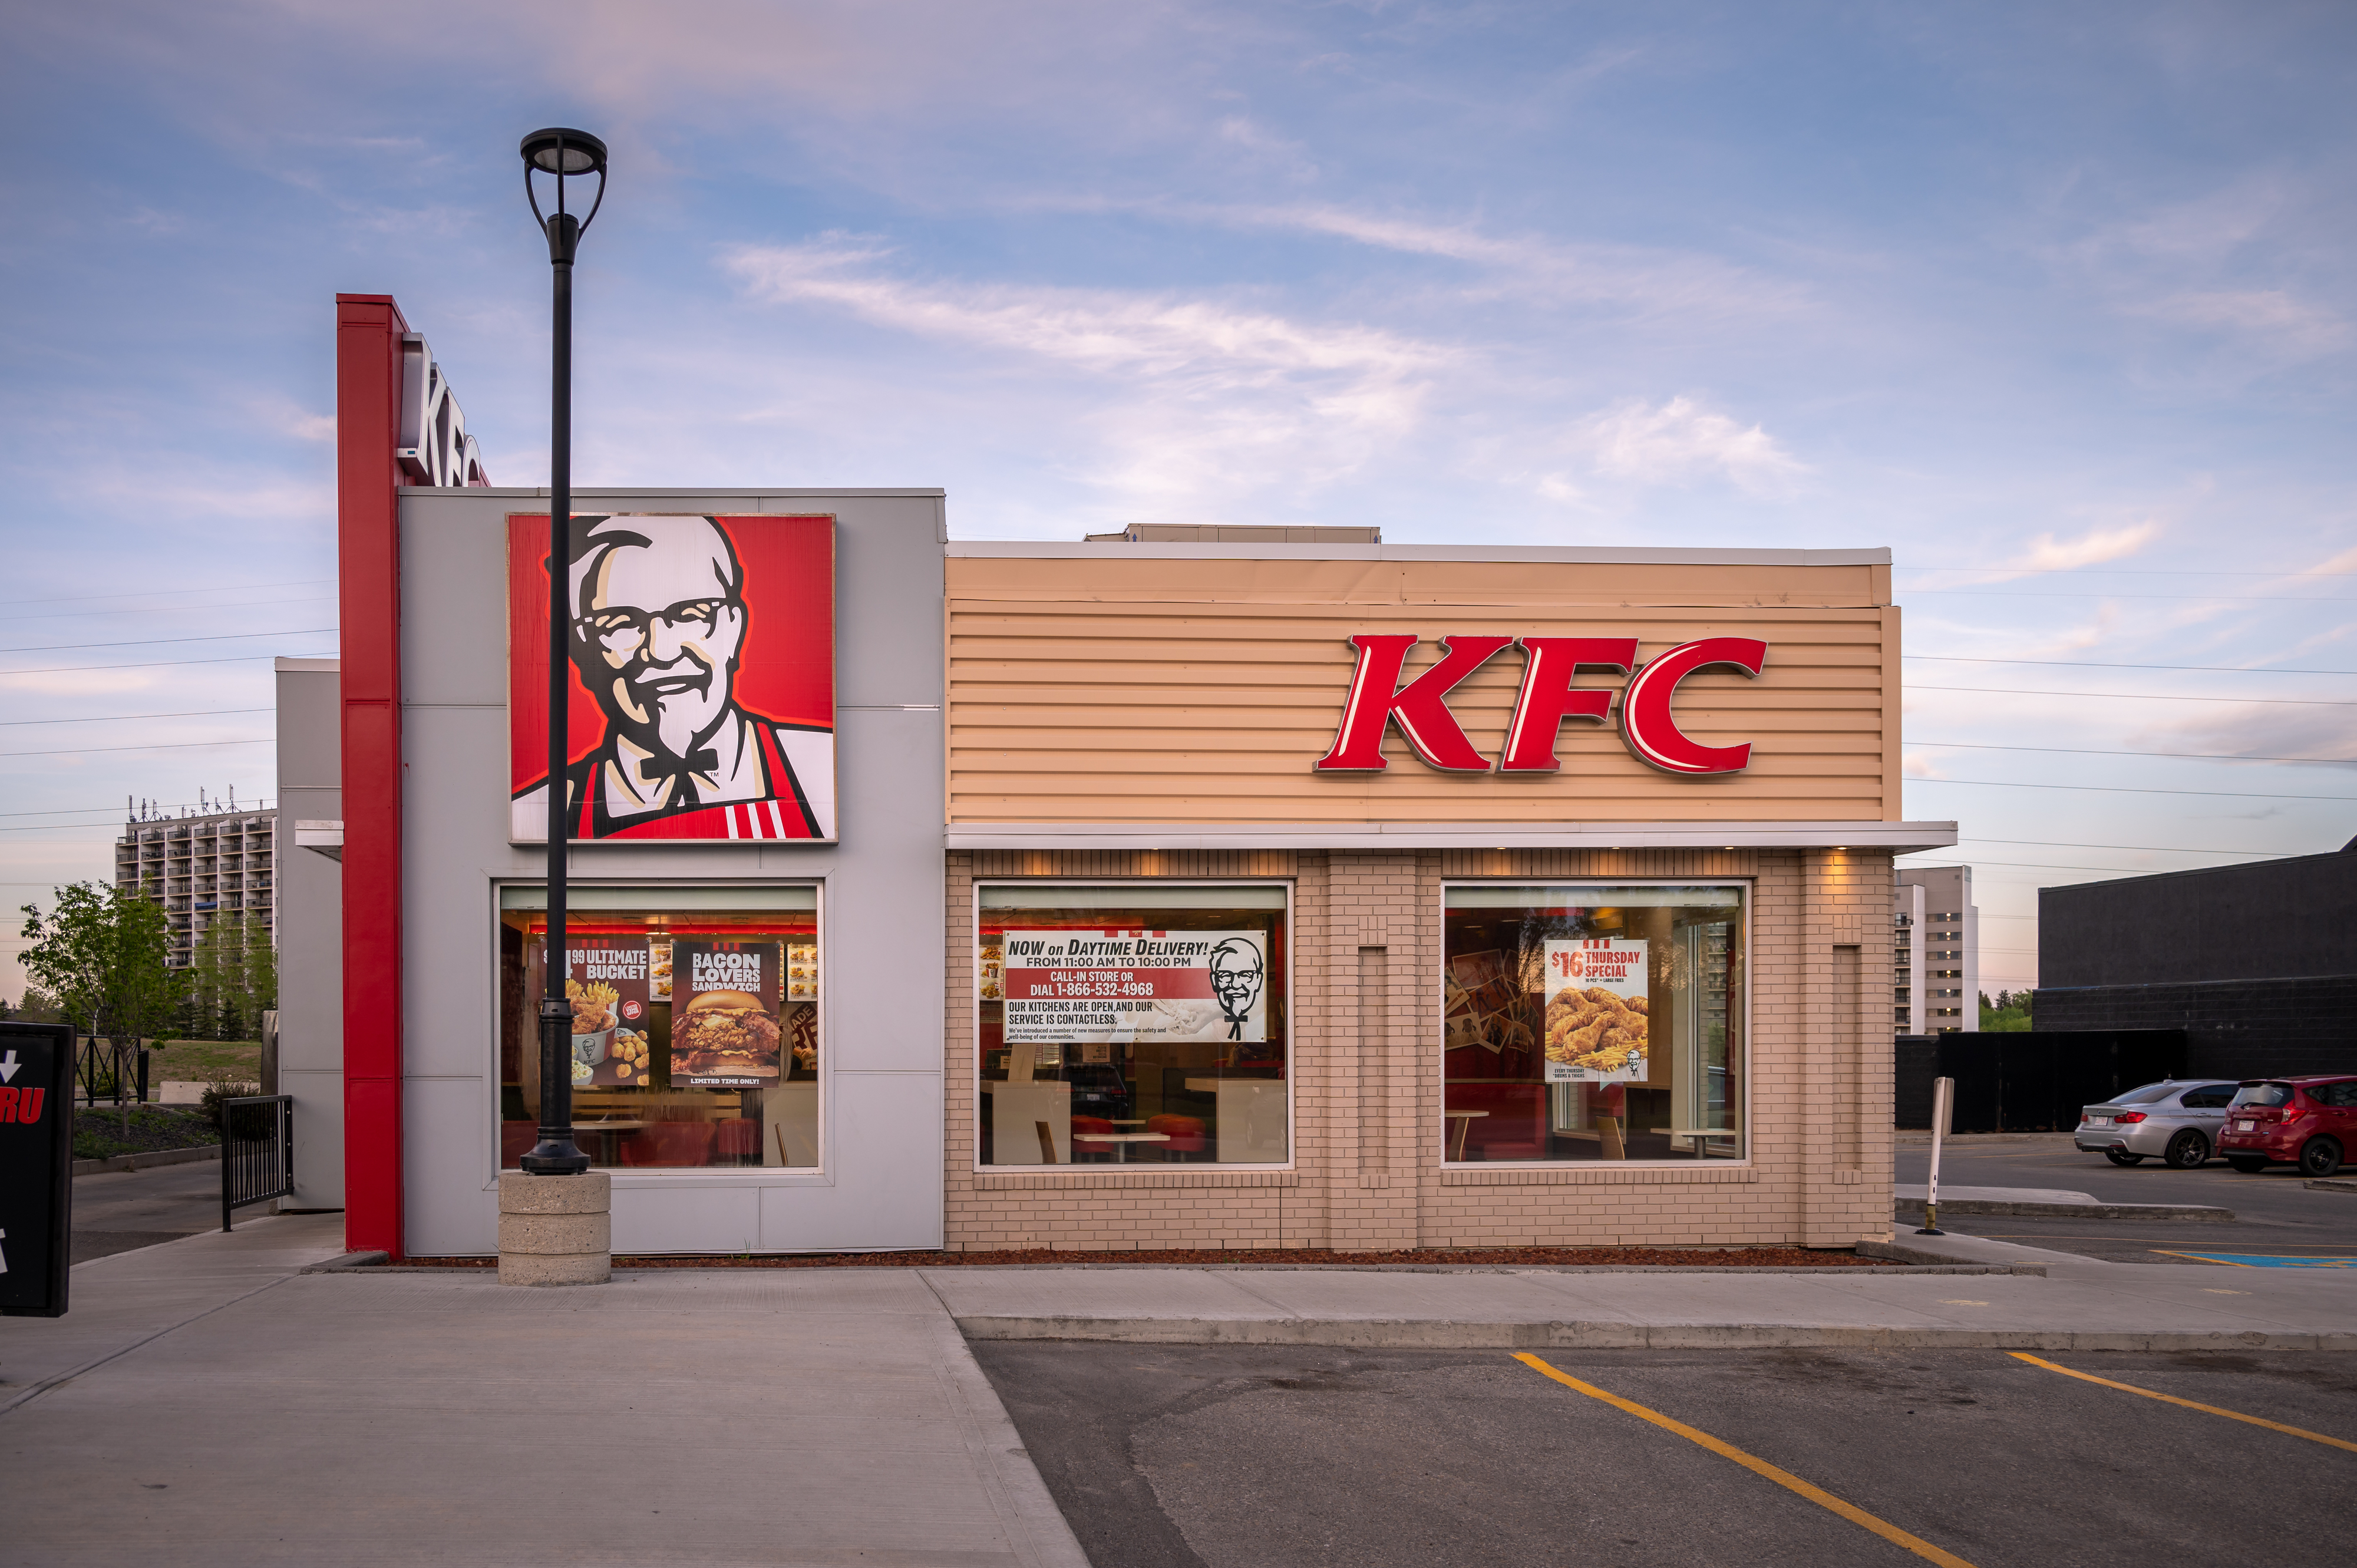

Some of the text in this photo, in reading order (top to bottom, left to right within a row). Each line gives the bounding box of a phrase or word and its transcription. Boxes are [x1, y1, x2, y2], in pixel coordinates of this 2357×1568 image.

[1312, 634, 1767, 774] KFC
[1008, 939, 1209, 956] NOW on DAYTIME DELIVERY!
[586, 949, 646, 964] ULTIMATE
[692, 953, 760, 969] BACON
[1026, 958, 1191, 967] FROM 11:00 AM TO 10:00 PM
[1551, 951, 1640, 977] $16 THURSDAY
[1585, 965, 1627, 977] SPECIAL
[586, 965, 646, 979] BUCKET
[692, 968, 760, 982] LOVERS
[1050, 971, 1134, 982] CALL-IN STORE OR
[692, 982, 760, 992] SANDWICH
[1031, 982, 1154, 996] DIAL 1-866-532-4968
[1009, 1002, 1026, 1012] OUR
[1029, 1002, 1070, 1012] KITCHENS
[1072, 1002, 1089, 1012] ARE
[1135, 1002, 1153, 1012] OUR
[1009, 1014, 1117, 1024] SERVICE IS CONTACTLESS.
